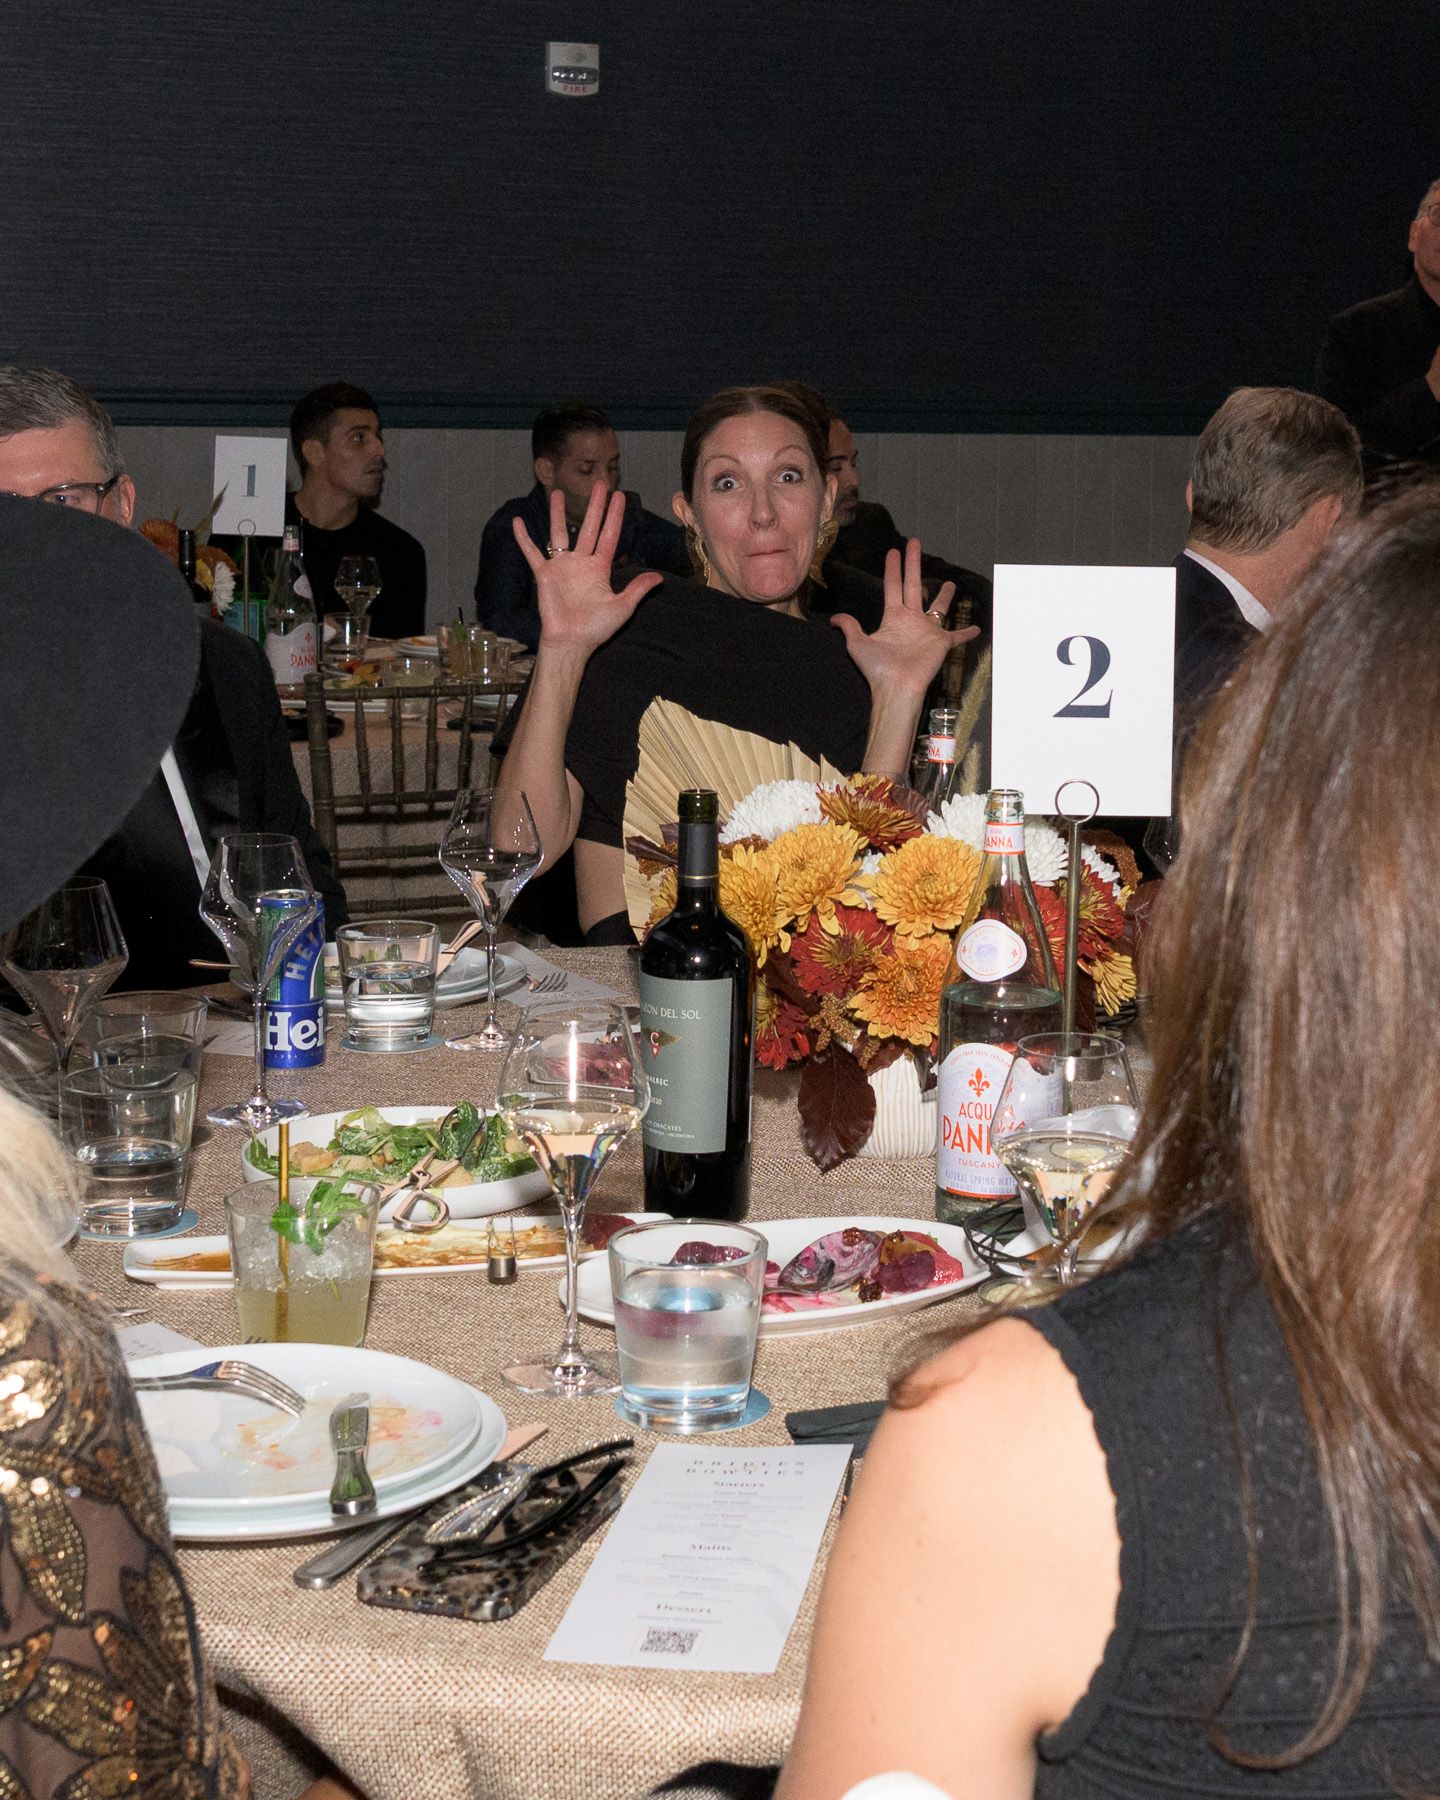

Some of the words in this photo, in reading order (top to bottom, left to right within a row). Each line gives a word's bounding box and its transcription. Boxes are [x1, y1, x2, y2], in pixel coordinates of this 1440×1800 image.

[563, 85, 587, 93] FIRE
[242, 464, 260, 497] 1
[1052, 635, 1114, 719] 2
[660, 1007, 678, 1019] DEL
[681, 1009, 702, 1021] SOL
[957, 1157, 1002, 1169] TUSCANY
[970, 1174, 995, 1187] SPRING
